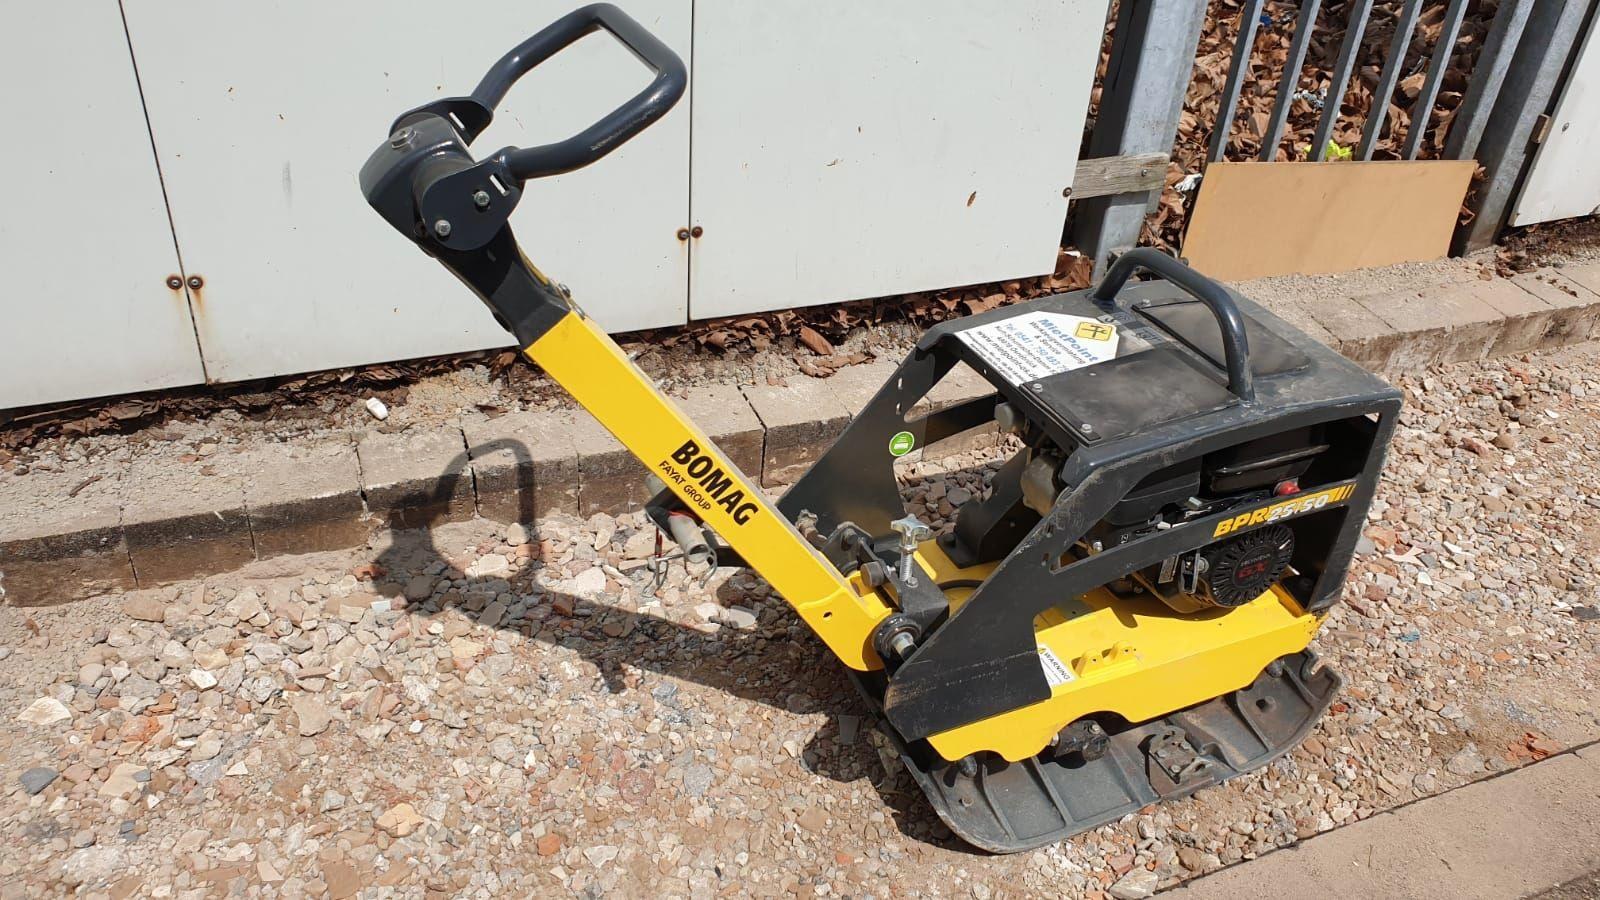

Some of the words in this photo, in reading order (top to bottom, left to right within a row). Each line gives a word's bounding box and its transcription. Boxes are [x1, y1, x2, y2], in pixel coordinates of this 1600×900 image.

[1038, 319, 1098, 362] MietPoint
[659, 460, 686, 485] FAYAT
[683, 484, 712, 510] GROUP
[671, 439, 759, 526] BOMAG
[1213, 507, 1269, 538] BPR
[1044, 652, 1071, 680] WARNING
